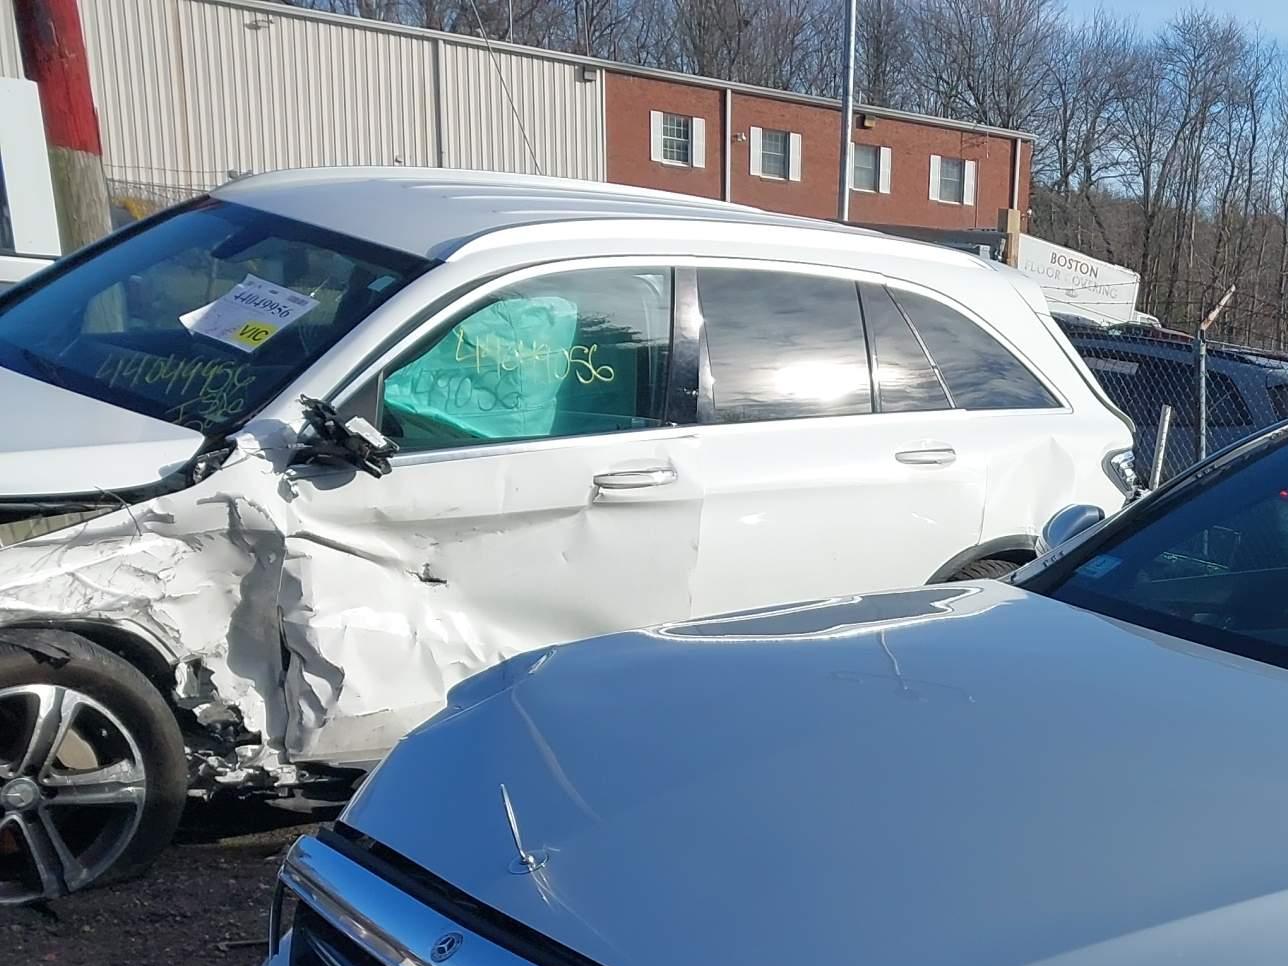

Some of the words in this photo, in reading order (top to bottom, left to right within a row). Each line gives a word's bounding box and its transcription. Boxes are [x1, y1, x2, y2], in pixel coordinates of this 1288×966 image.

[1050, 252, 1099, 278] BOSTON
[1069, 274, 1118, 299] OVERING
[239, 324, 269, 341] VIC
